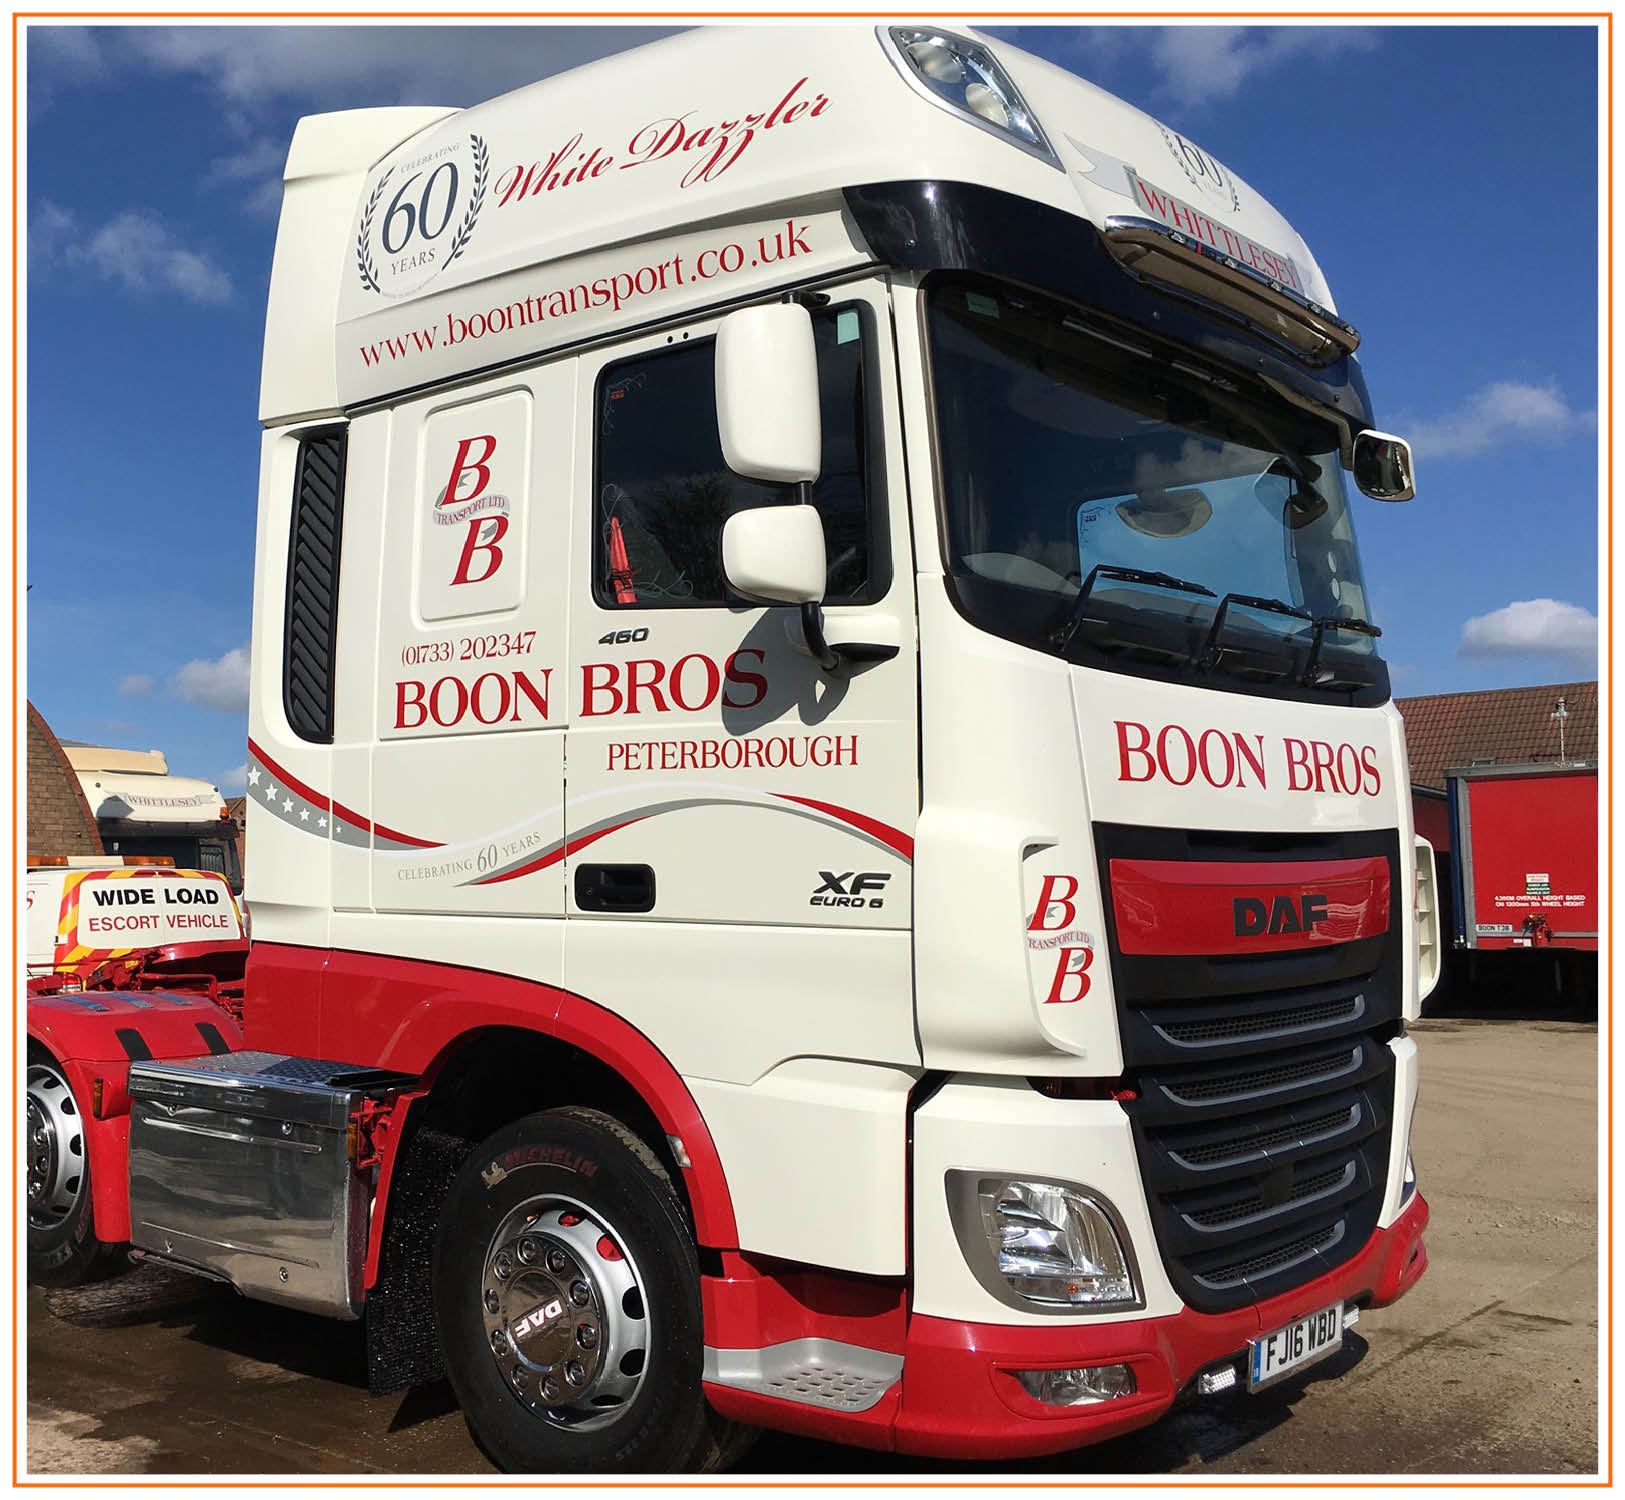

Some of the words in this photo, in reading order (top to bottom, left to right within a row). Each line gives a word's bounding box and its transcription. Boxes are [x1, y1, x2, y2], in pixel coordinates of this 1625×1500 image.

[400, 142, 461, 174] CELEBRATING
[494, 133, 614, 208] White
[620, 77, 833, 188] Dazzler
[382, 162, 459, 254] 60
[1137, 179, 1298, 289] WHITTLESEY
[391, 247, 437, 276] YEARS
[360, 219, 814, 368] www.boontransport.co.uk
[439, 434, 497, 507] B
[437, 497, 486, 526] TRANSPORT
[488, 495, 505, 509] LTD
[449, 515, 509, 586] B
[401, 639, 454, 667] (01733)
[460, 631, 537, 661] 202347
[598, 627, 649, 645] 460
[393, 668, 554, 729] BOON
[578, 648, 769, 717] BROS
[605, 735, 859, 771] PETERBOROUGH
[1113, 720, 1267, 790] BOON
[1282, 737, 1382, 797] BROS
[397, 858, 473, 881] CELEBRATING
[477, 844, 499, 872] 60
[503, 831, 542, 858] YEARS
[92, 889, 156, 907] WIDE
[164, 888, 220, 905] LOAD
[809, 895, 866, 908] EURO
[868, 897, 884, 909] 6
[813, 871, 892, 895] XF
[1026, 875, 1079, 931] B
[88, 915, 161, 932] ESCORT
[166, 914, 229, 929] VEHICLE
[1232, 894, 1329, 938] DAF
[1027, 931, 1074, 950] RANSPORT
[1076, 931, 1090, 944] LTD
[1043, 947, 1095, 1004] B
[504, 1145, 599, 1177] MICHELIN
[514, 1299, 563, 1339] DAF
[1266, 1325, 1304, 1371] FJ16
[1308, 1309, 1337, 1352] WBD
